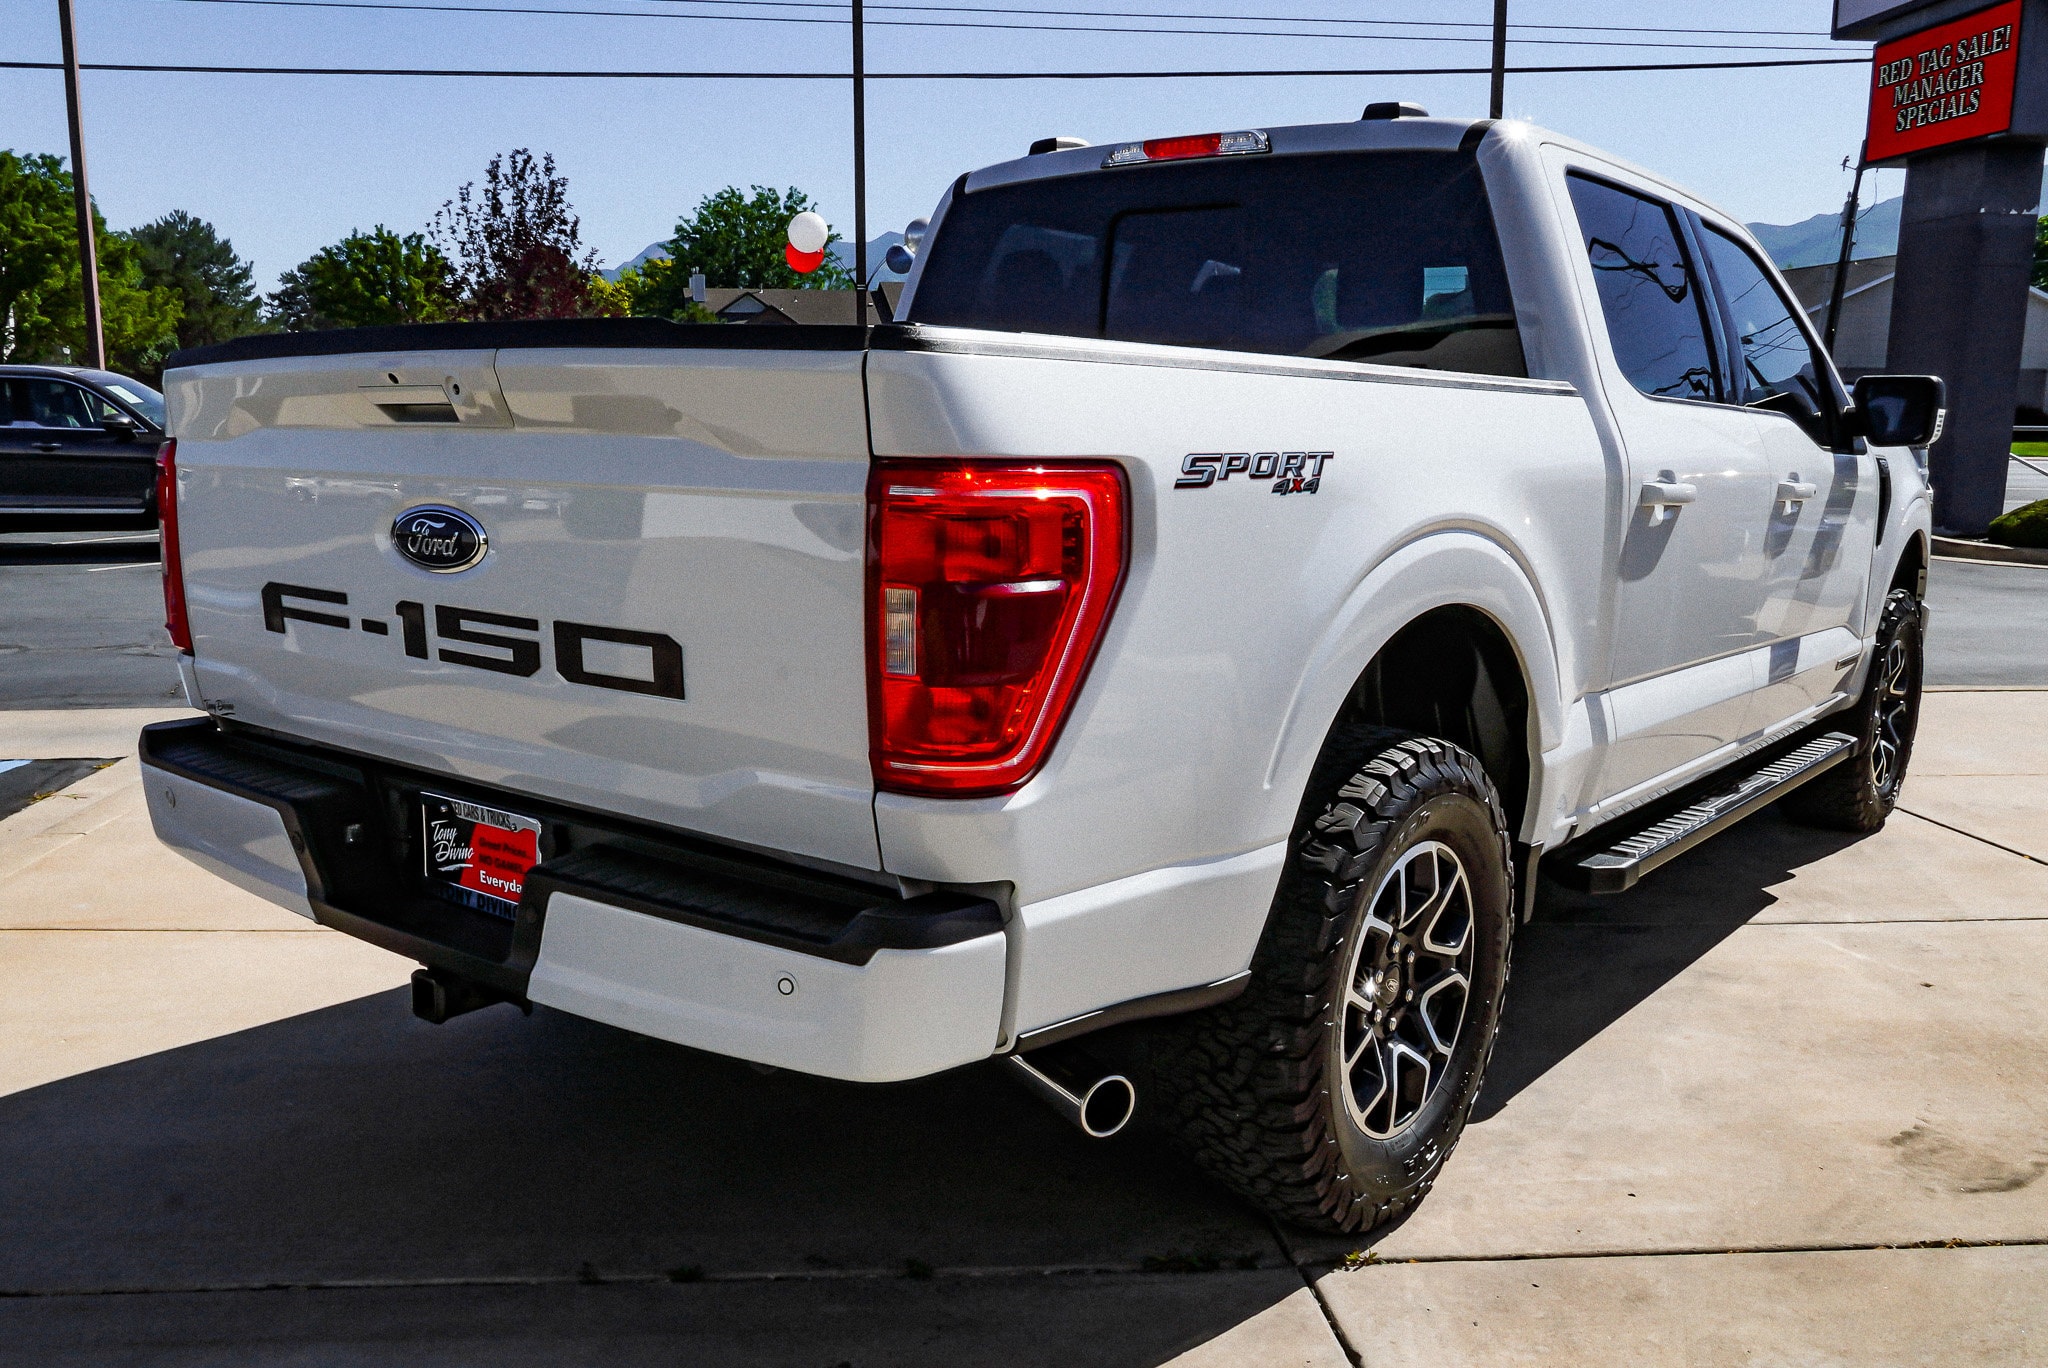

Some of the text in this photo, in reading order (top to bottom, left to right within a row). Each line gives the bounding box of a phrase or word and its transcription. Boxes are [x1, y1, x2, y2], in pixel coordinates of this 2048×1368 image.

[1878, 25, 2011, 87] RED TAG SALE!
[1893, 61, 1984, 108] MANAGER
[1896, 89, 1980, 131] SPECIALS
[1174, 451, 1334, 490] SPORT
[407, 518, 458, 558] Ford
[261, 581, 685, 700] F-150
[430, 820, 458, 847] Tony
[433, 840, 474, 862] Divino
